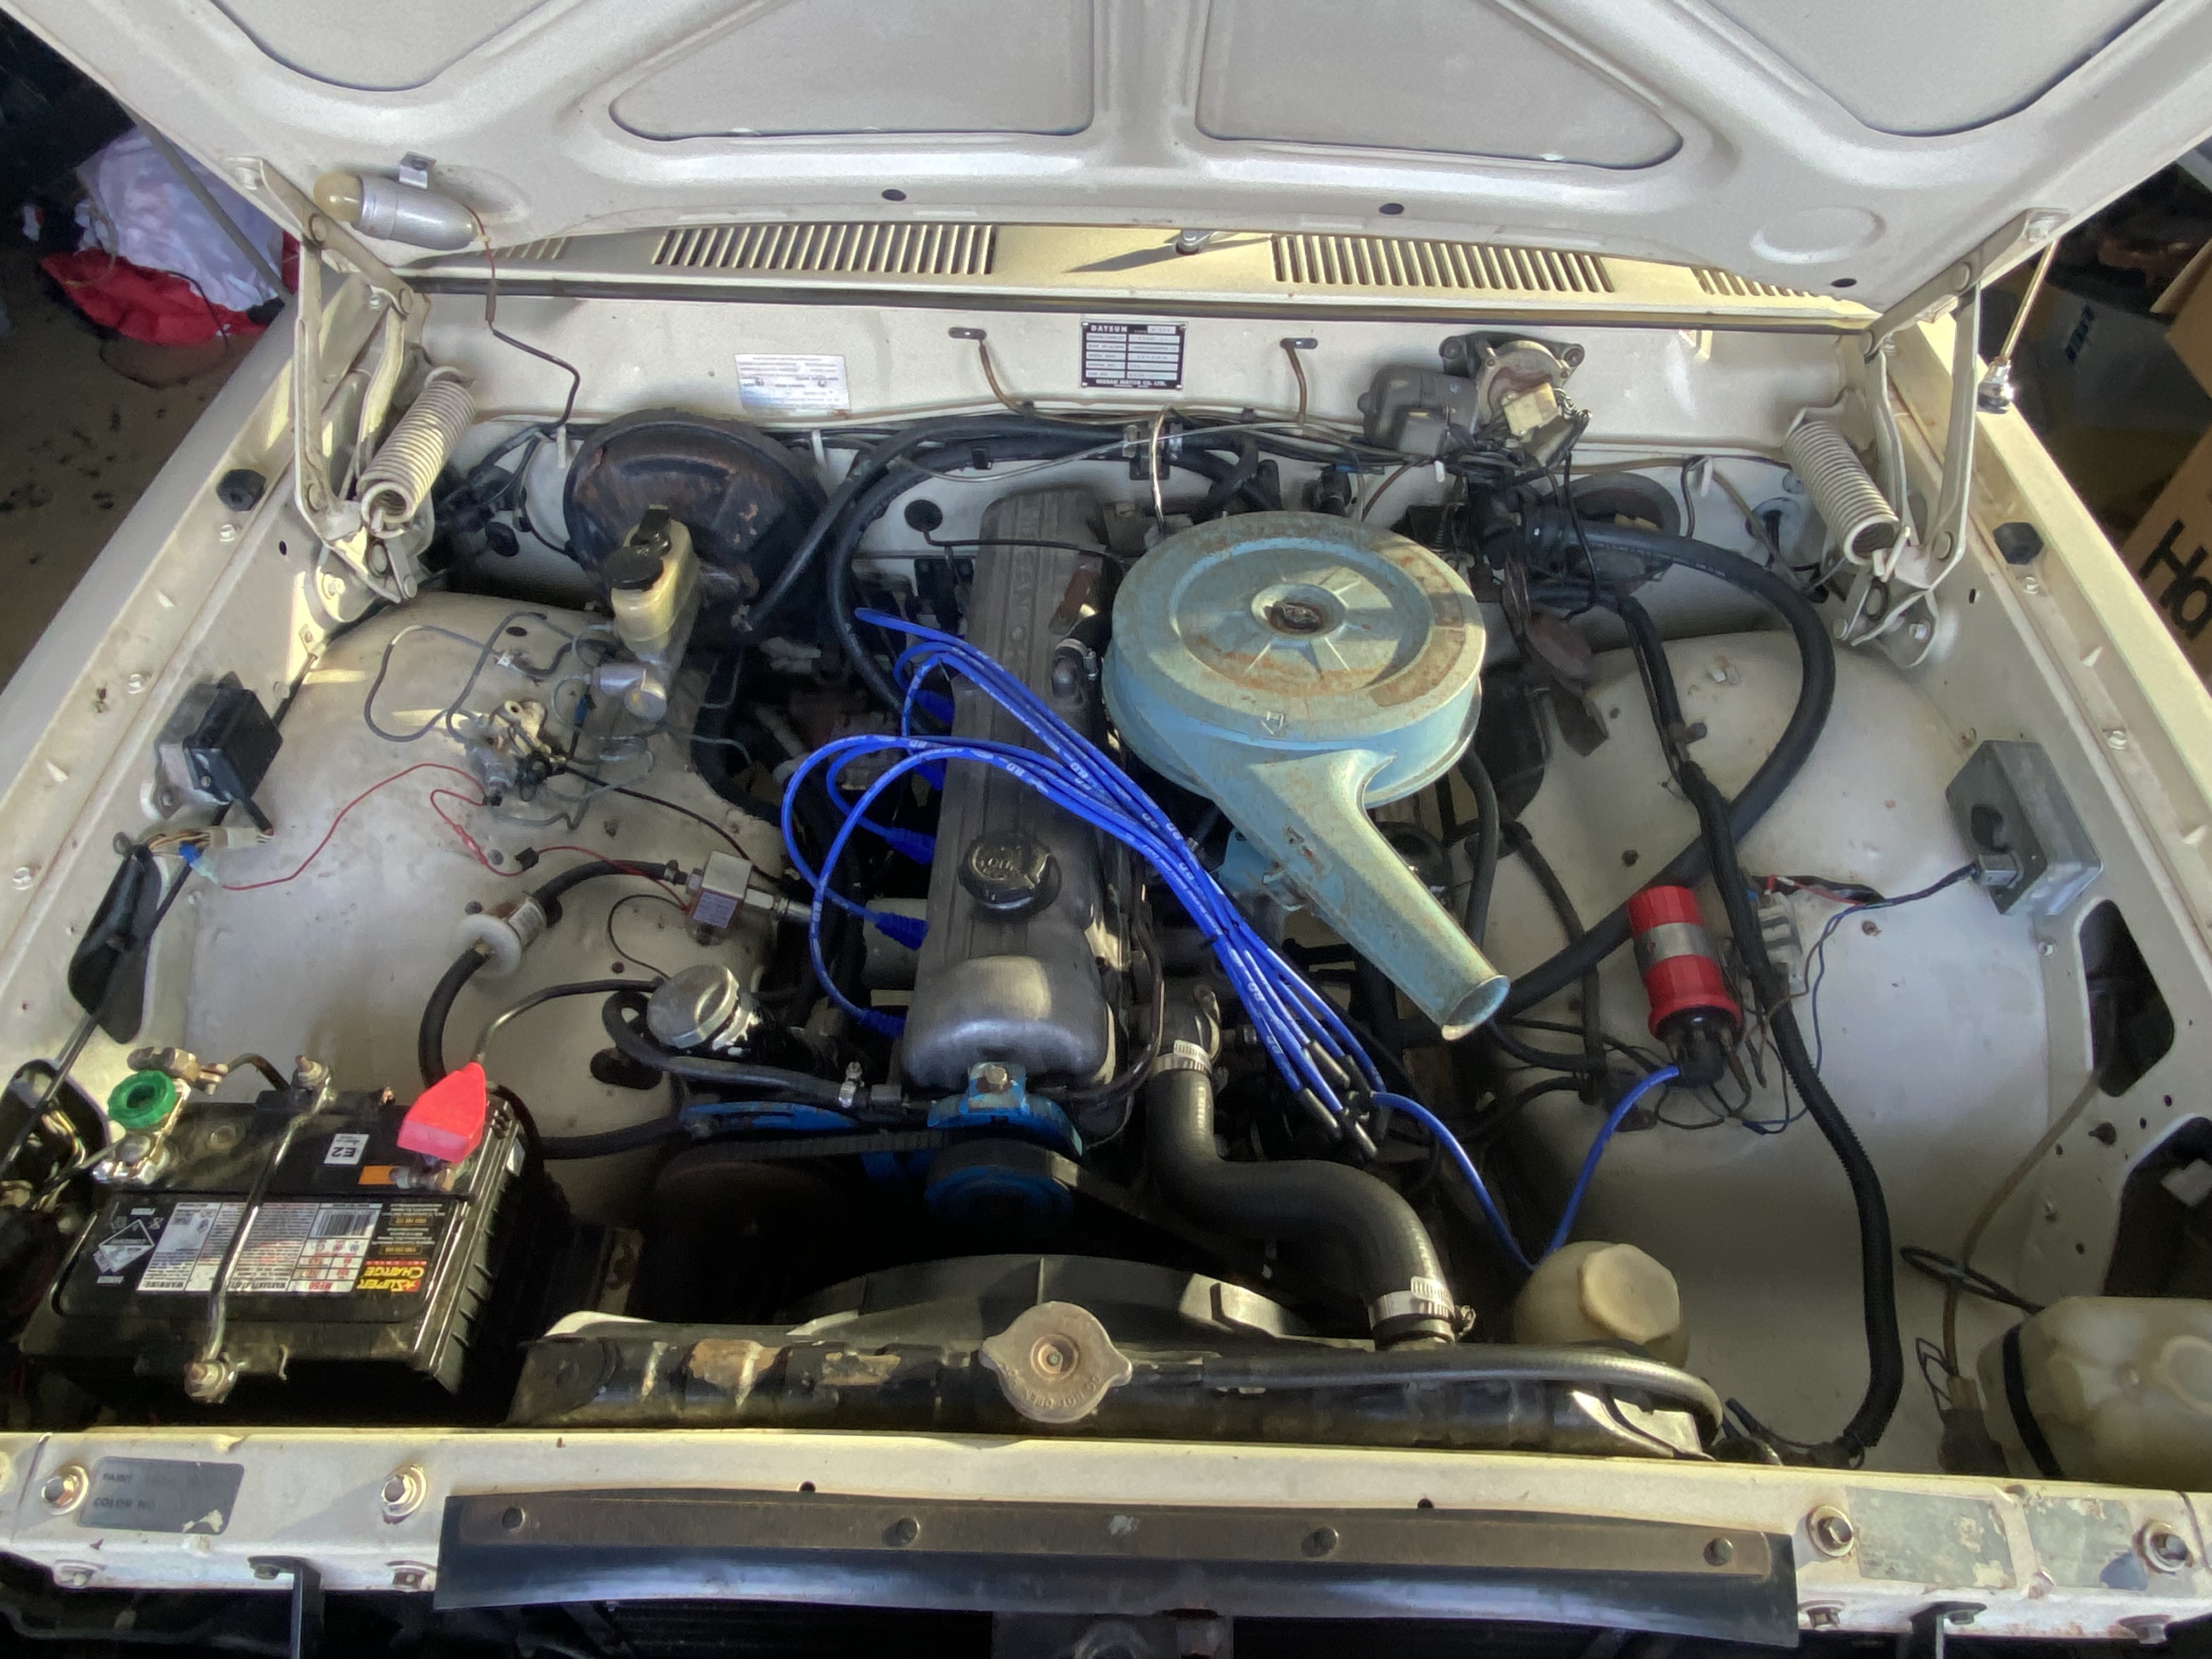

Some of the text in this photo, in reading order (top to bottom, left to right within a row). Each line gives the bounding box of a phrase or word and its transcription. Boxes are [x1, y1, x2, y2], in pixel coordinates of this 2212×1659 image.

[1091, 325, 1128, 333] DATSUN
[331, 1147, 356, 1157] E2
[364, 1266, 425, 1279] CHARGE
[357, 1279, 404, 1292] SUPER
